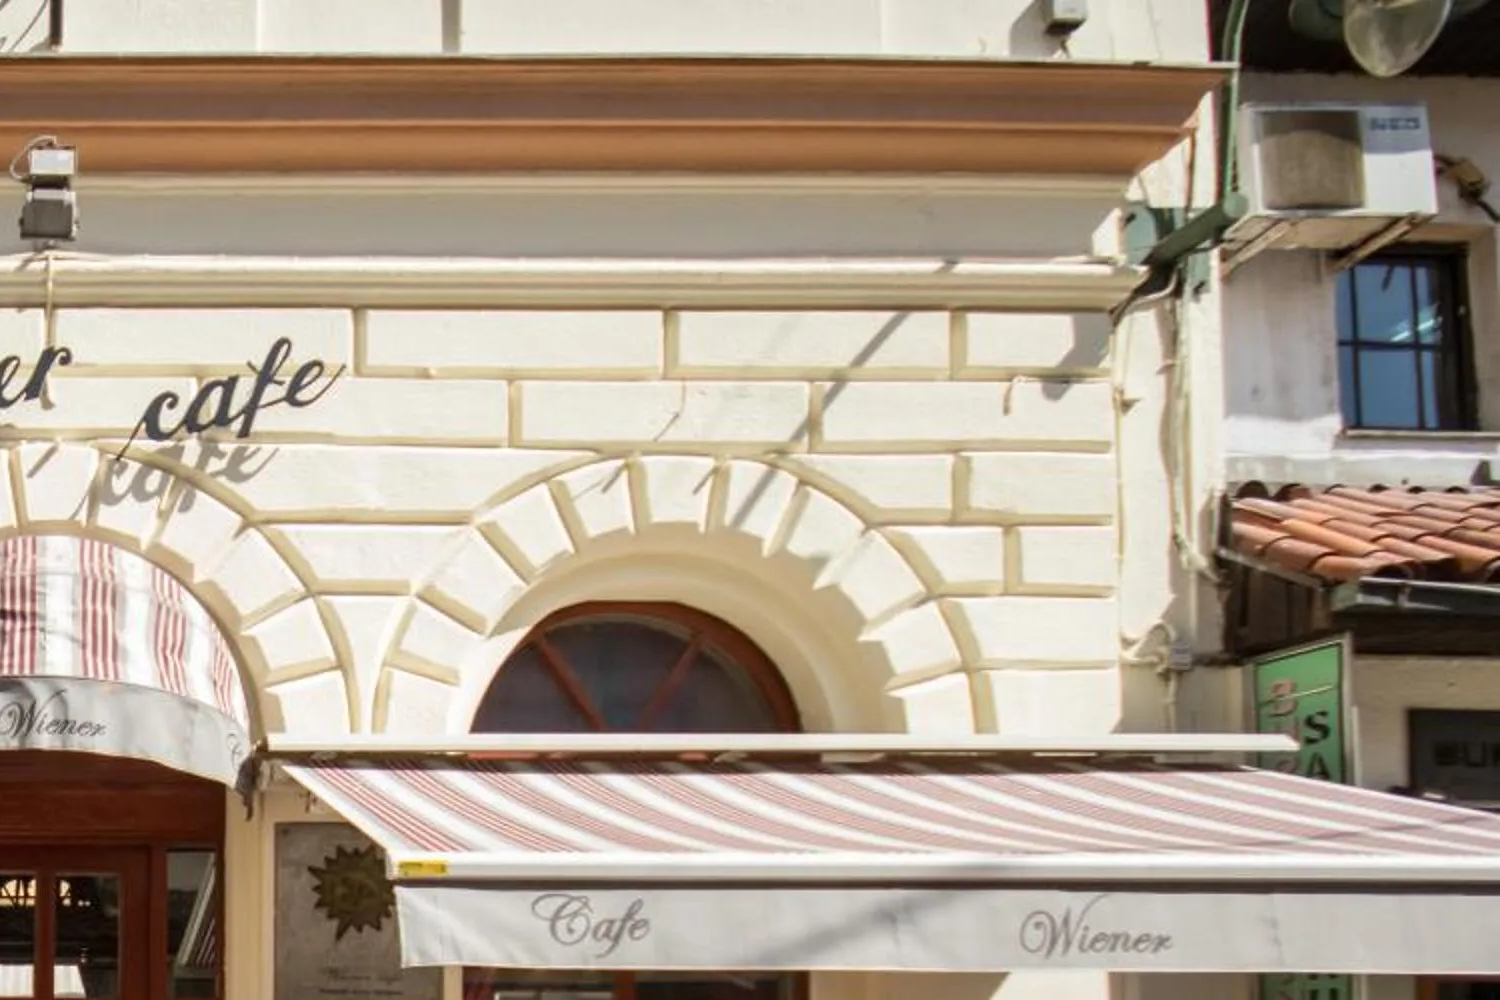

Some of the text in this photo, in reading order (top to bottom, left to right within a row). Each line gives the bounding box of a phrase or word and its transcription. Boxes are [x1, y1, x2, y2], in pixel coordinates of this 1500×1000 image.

[115, 336, 346, 461] cafe
[531, 893, 651, 958] Cafe
[1019, 894, 1173, 959] Wiener
